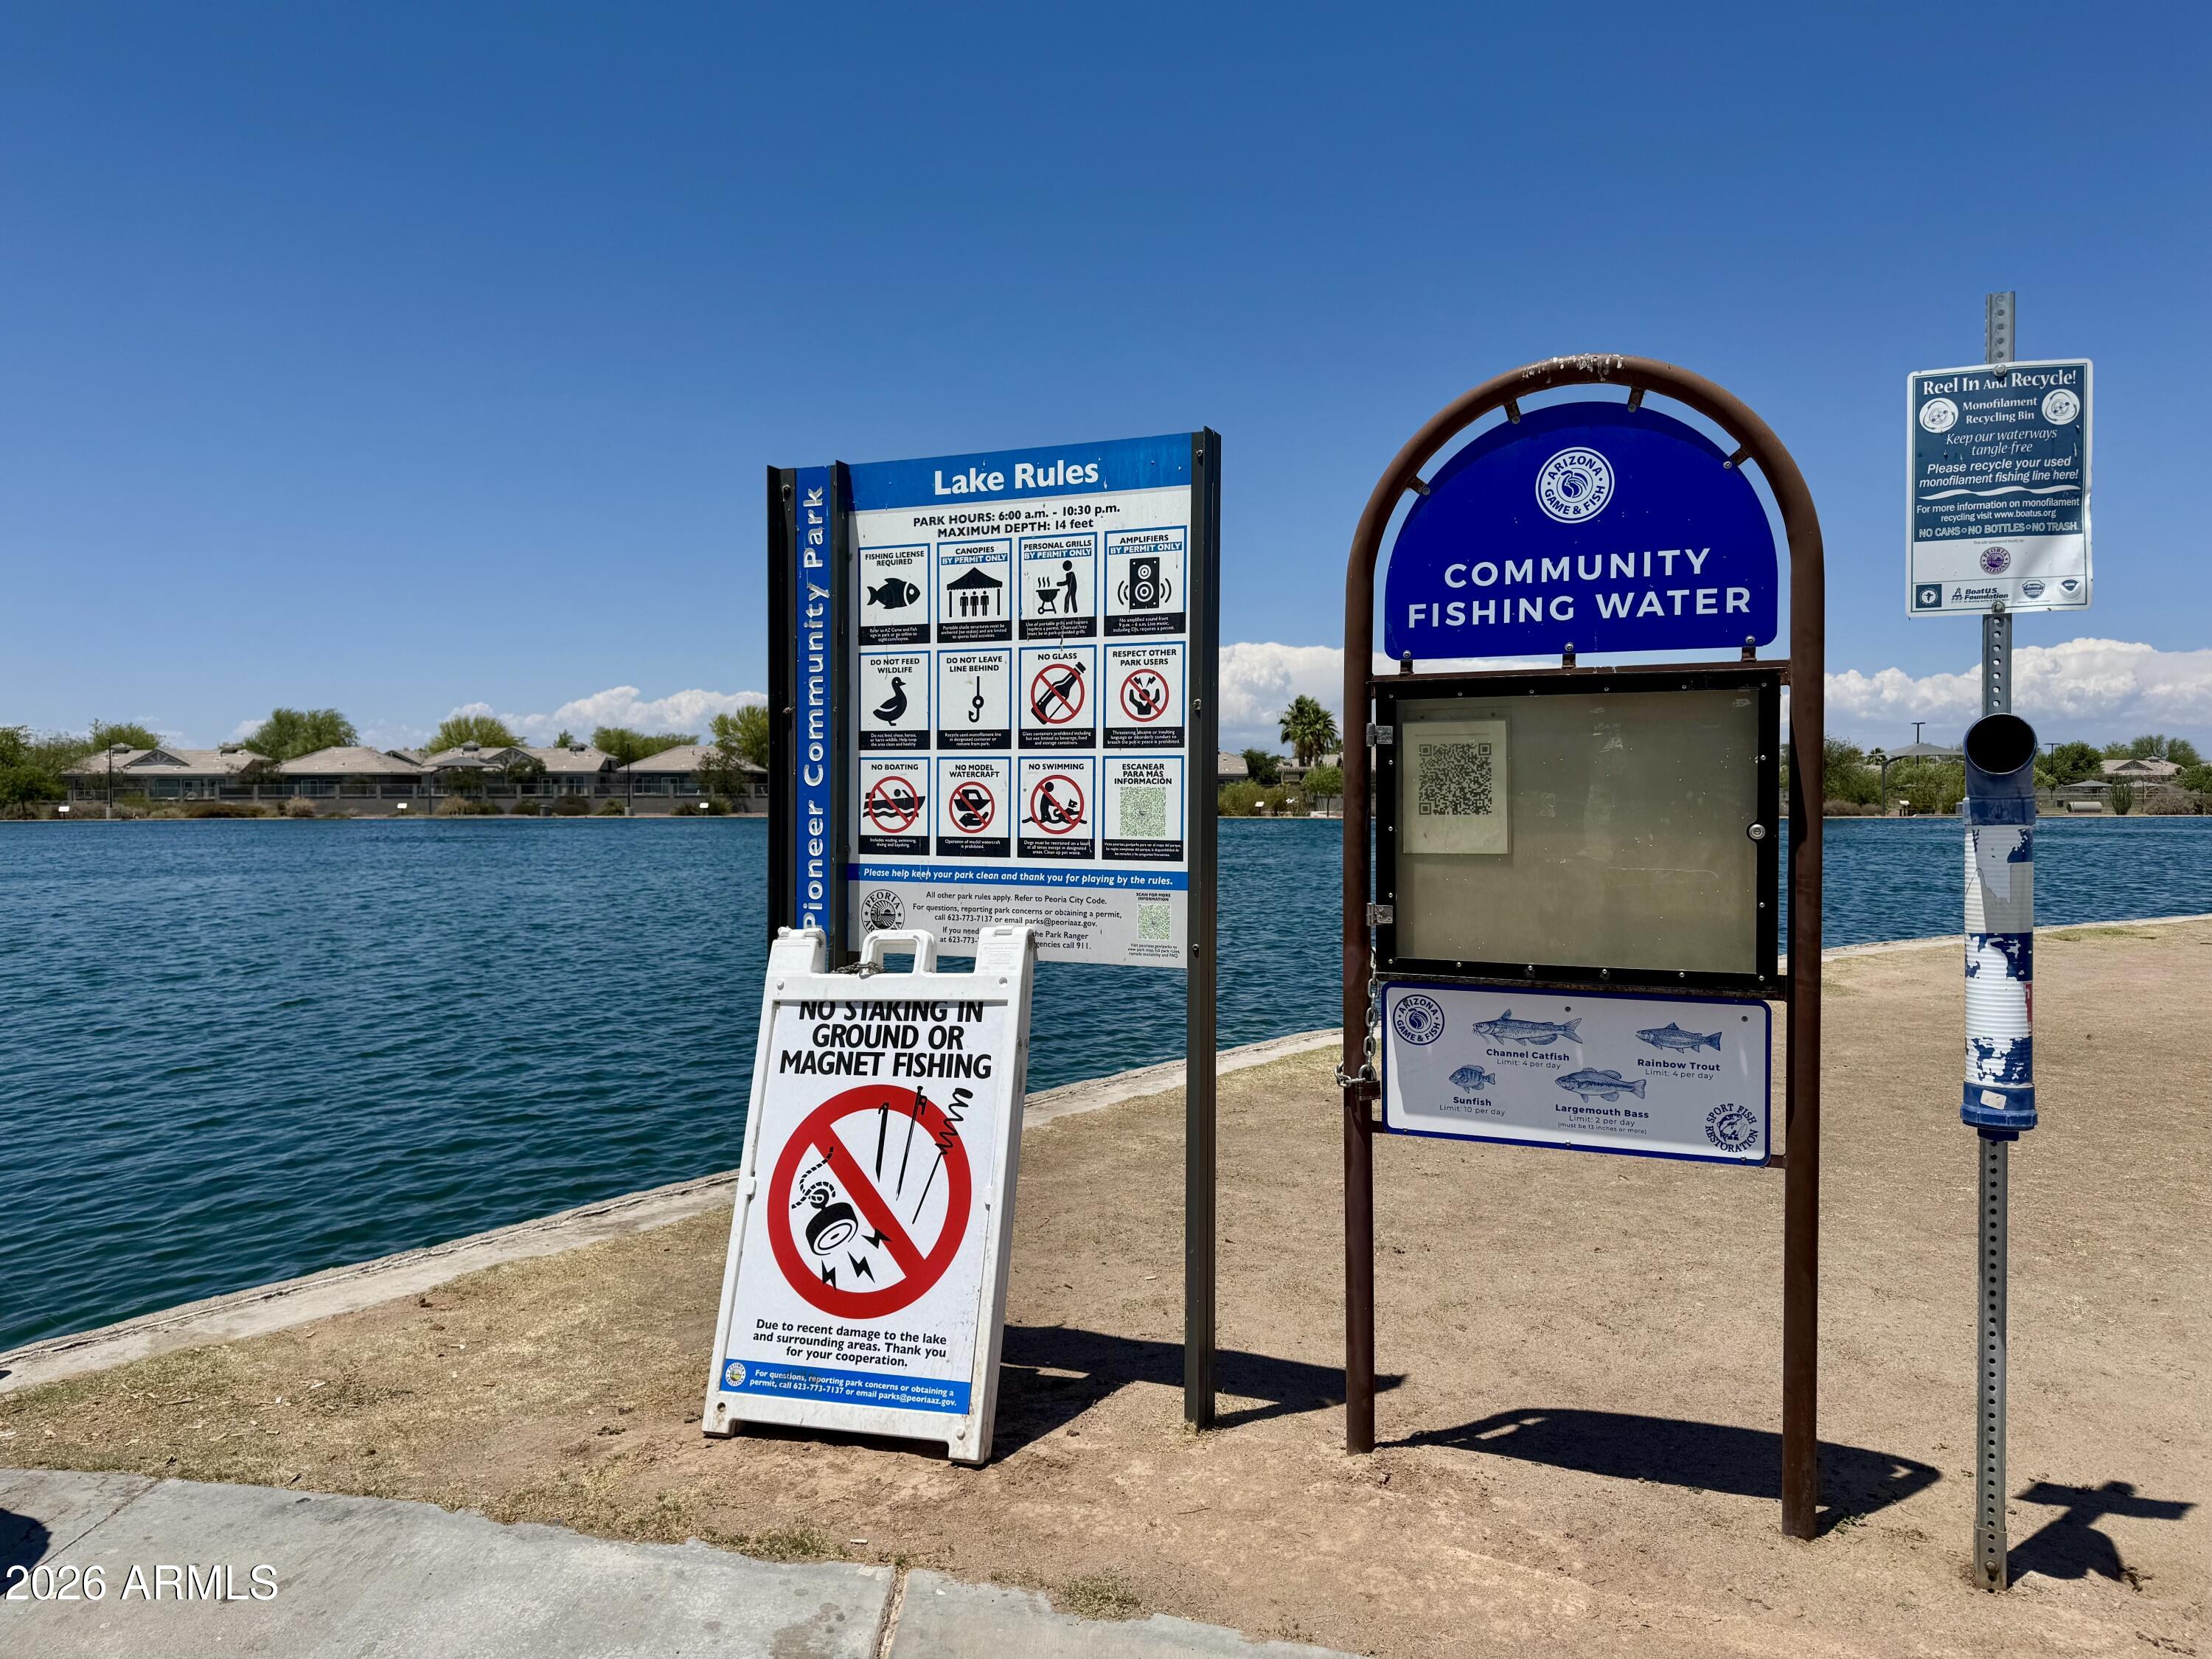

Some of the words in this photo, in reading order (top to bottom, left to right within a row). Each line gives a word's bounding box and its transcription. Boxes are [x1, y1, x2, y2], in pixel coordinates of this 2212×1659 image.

[1924, 378, 1958, 394] Reel
[1963, 378, 1979, 391] In
[1983, 378, 2007, 389] And
[2011, 370, 2076, 389] Recycle!
[1963, 397, 2037, 410] Monofilament
[1966, 412, 2015, 424] Recycling
[2018, 411, 2034, 420] Bin
[1946, 433, 1972, 445] Keep
[1975, 432, 1995, 442] our
[1997, 429, 2056, 443] waterways
[1972, 442, 2032, 456] tangle-free
[1548, 456, 1603, 480] ARIZONA
[1927, 463, 1966, 474] Please
[1969, 459, 2011, 472] recycle
[2014, 459, 2041, 470] your
[2044, 456, 2071, 467] used
[934, 467, 1004, 495] Lake
[1015, 460, 1099, 488] Rules
[1919, 473, 1993, 487] monofilament
[1995, 471, 2029, 483] fishing
[2032, 471, 2050, 480] line
[2053, 469, 2078, 479] here!
[1545, 488, 1571, 515] GAME
[1572, 505, 1582, 515] &
[1583, 485, 1606, 512] FISH
[914, 515, 945, 526] PARK
[949, 512, 995, 524] HOURS:
[998, 510, 1020, 521] 6:00
[1024, 510, 1048, 518] a.m.
[1063, 505, 1091, 516] 10:30
[1095, 505, 1119, 516] p.m.
[803, 486, 823, 568] Park
[938, 524, 1000, 538] MAXIMUM
[1004, 521, 1050, 533] DEPTH:
[1055, 520, 1066, 529] 14
[1069, 518, 1093, 529] feet
[1023, 541, 1063, 550] PERSONAL
[1119, 535, 1168, 543] AMPLIFIERS
[895, 550, 924, 558] LICENSE
[955, 546, 994, 554] CANOPIES
[1037, 550, 1067, 558] PERMIT
[1069, 549, 1091, 557] ONLY
[1124, 544, 1155, 553] PERMIT
[877, 558, 912, 566] REQUIRED
[954, 555, 984, 563] PERMIT
[1444, 548, 1710, 588] COMMUNITY
[1408, 596, 1573, 627] FISHING
[1595, 587, 1750, 618] WATER
[803, 582, 830, 787] Community
[1114, 776, 1172, 785] INFORMACIÓN
[1146, 769, 1163, 778] MÁS
[802, 801, 823, 929] Pioneer
[863, 868, 889, 876] Please
[891, 869, 909, 879] help
[911, 869, 931, 880] keep
[933, 872, 952, 880] your
[954, 871, 973, 880] park
[975, 871, 998, 879] clean
[1020, 872, 1045, 880] thank
[1047, 874, 1062, 883] you
[1065, 873, 1079, 883] for
[1082, 874, 1114, 885] playing
[1116, 874, 1127, 886] by
[1130, 875, 1145, 883] the
[1147, 876, 1172, 885] rules.
[866, 891, 900, 909] PEORIA
[957, 892, 972, 900] park
[992, 894, 1012, 902] apply.
[1068, 896, 1083, 905] City
[799, 1001, 835, 1020] NO
[844, 1001, 947, 1021] STAKING
[957, 1001, 983, 1022] IN
[812, 1023, 919, 1048] GROUND
[928, 1025, 964, 1050] OR
[1486, 1048, 1528, 1058] Channel
[1531, 1051, 1569, 1060] Catfish
[779, 1050, 885, 1076] MAGNET
[892, 1052, 991, 1079] FISHING
[1638, 1059, 1686, 1068] Rainbow
[1689, 1062, 1719, 1071] Trout
[1453, 1096, 1491, 1106] Sunfish
[1490, 1108, 1505, 1116] day
[1555, 1104, 1620, 1116] Largemouth
[1624, 1110, 1649, 1118] Bass
[756, 1318, 778, 1329] Due
[782, 1322, 793, 1331] to
[796, 1324, 832, 1335] recent
[836, 1326, 880, 1340] damage
[884, 1331, 896, 1340] to
[900, 1332, 919, 1342] the
[922, 1333, 946, 1344] lake
[753, 1332, 773, 1341] and
[776, 1335, 844, 1350] surrounding
[847, 1340, 880, 1351] areas.
[885, 1342, 921, 1355] Thank
[925, 1348, 946, 1357] you
[786, 1346, 803, 1356] for
[806, 1350, 832, 1360] your
[835, 1352, 907, 1366] cooperation.
